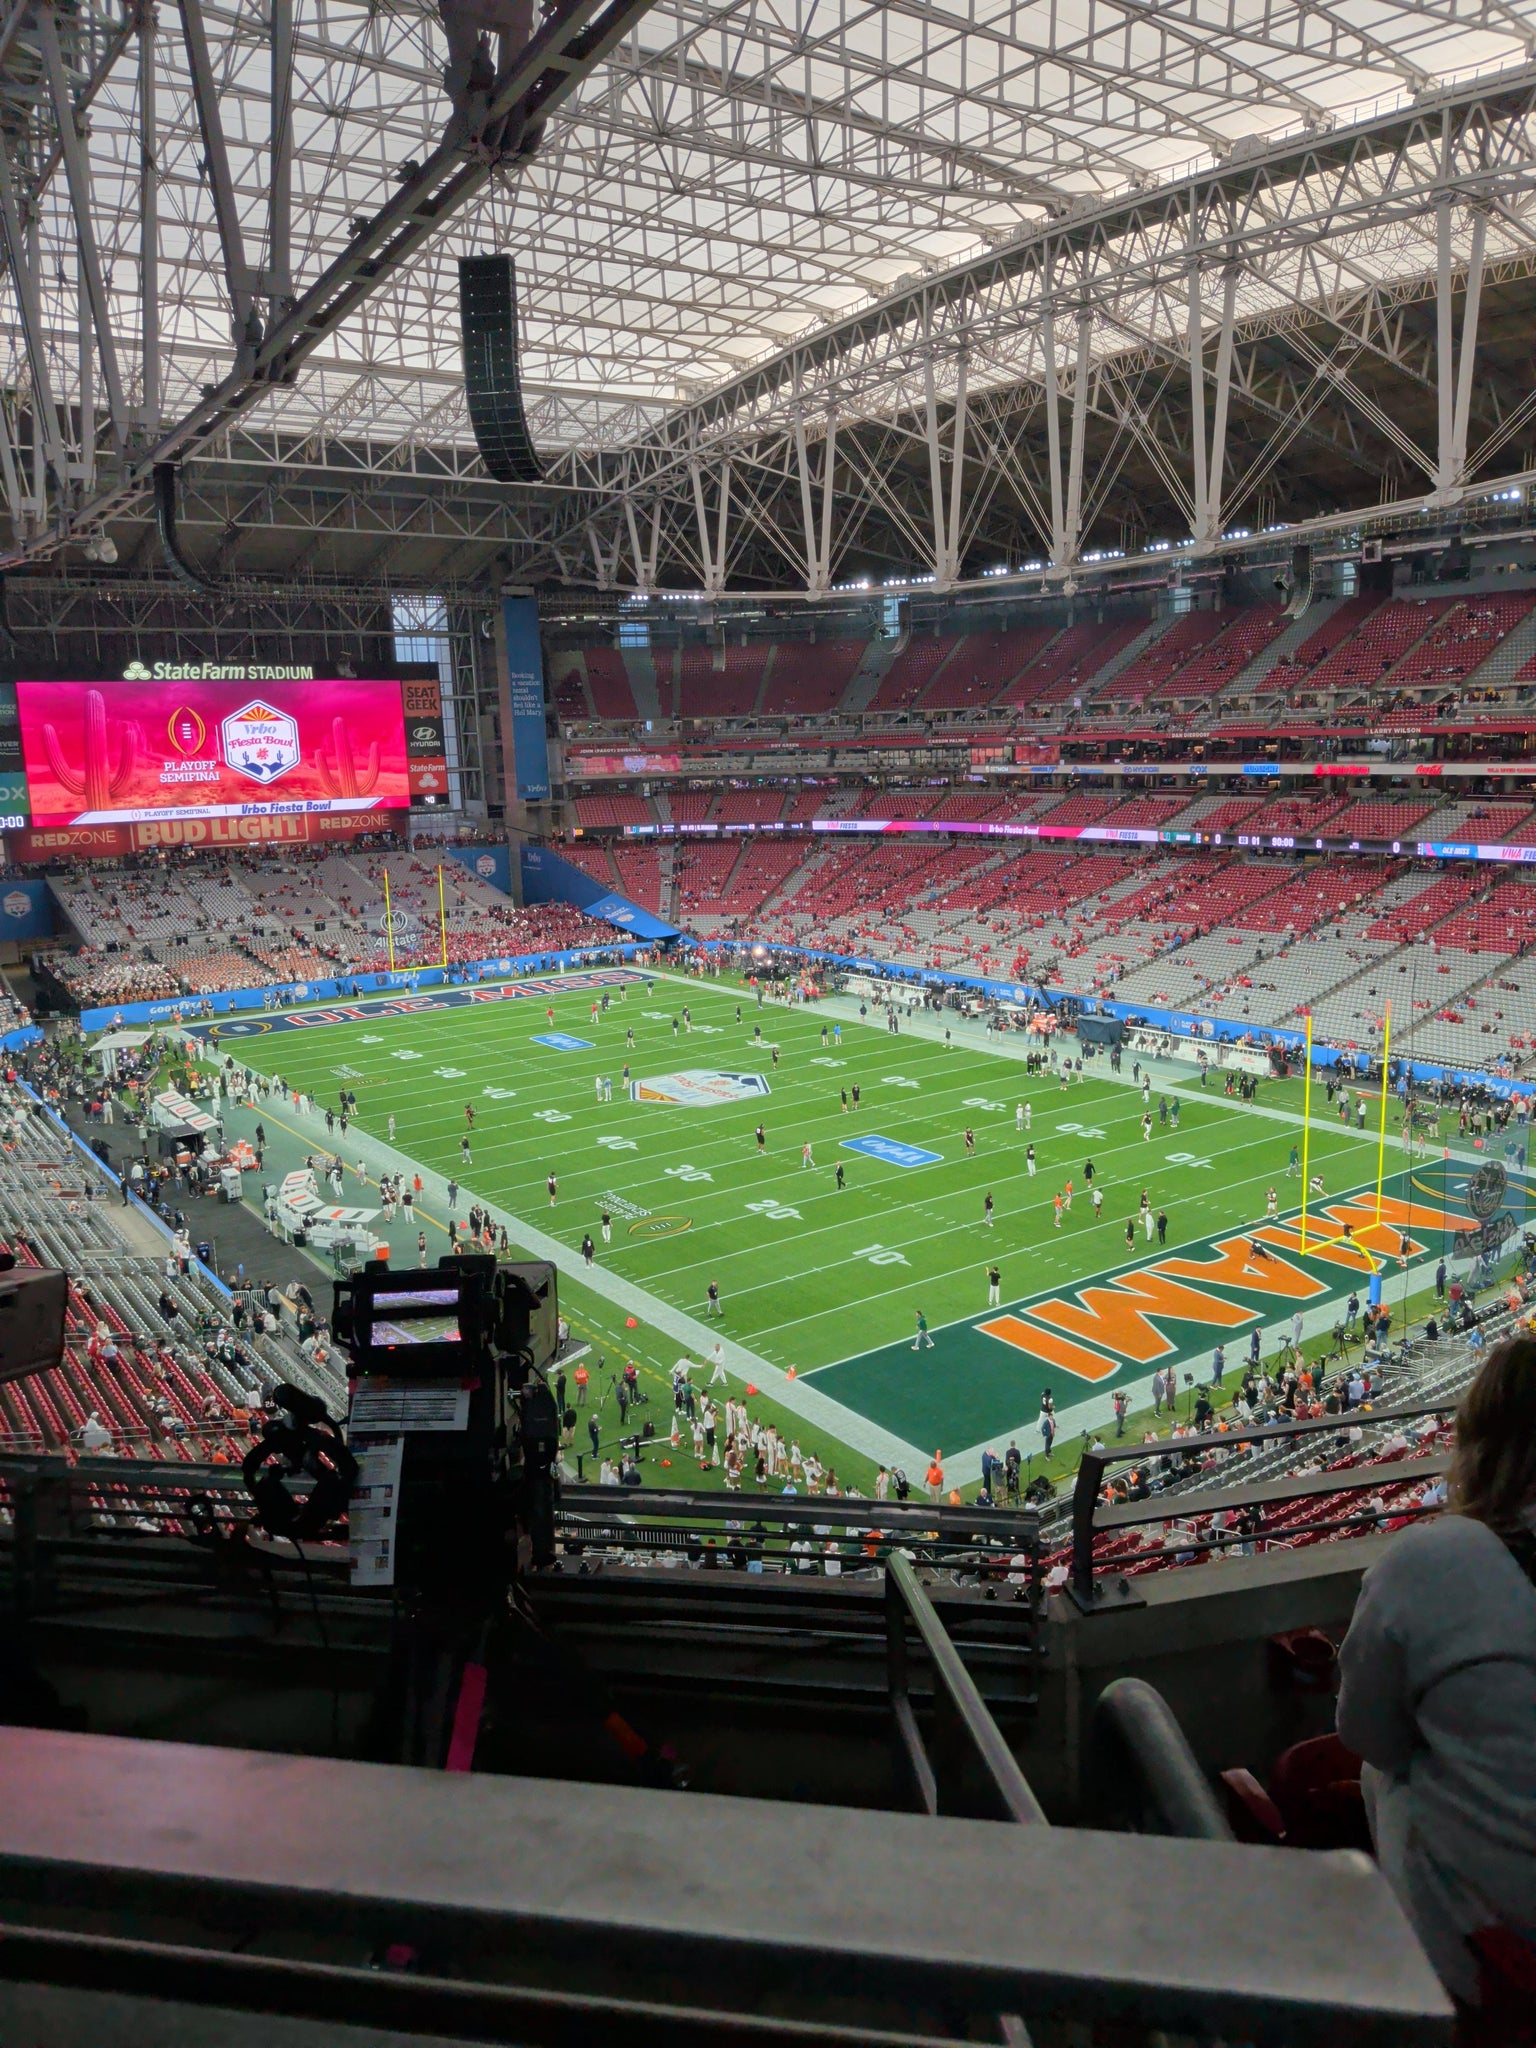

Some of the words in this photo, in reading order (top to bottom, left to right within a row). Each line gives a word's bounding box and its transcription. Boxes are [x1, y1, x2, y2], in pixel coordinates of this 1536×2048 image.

[248, 666, 314, 680] STADIUM
[407, 686, 435, 699] SEAT
[406, 699, 438, 711] GEEK
[244, 723, 277, 735] Vrbo
[228, 736, 263, 749] Fiesta
[263, 735, 294, 748] Bowl
[163, 760, 217, 772] PLAYOFF
[1189, 765, 1208, 774] COX
[527, 784, 548, 793] Vrbo
[175, 808, 211, 816] SEMIFINAL
[241, 803, 267, 815] Vrbo
[269, 802, 303, 813] Fiesta
[305, 800, 332, 812] Bowl
[320, 814, 390, 830] REDZONE
[1004, 824, 1023, 834] Fiesta
[137, 820, 207, 846] BUD
[210, 814, 302, 841] LIGHT
[1119, 831, 1138, 840] FIESTA
[30, 829, 118, 848] REDZONE
[1271, 836, 1294, 848] 90:00
[1501, 848, 1522, 859] VIVA
[374, 933, 417, 948] Allstate
[284, 996, 449, 1027] OLE
[460, 970, 643, 1001] MISS
[532, 1109, 573, 1123] 50
[1055, 1122, 1108, 1140] 20
[596, 1135, 636, 1151] 40
[663, 1164, 712, 1182] 30
[743, 1199, 800, 1220] 20
[851, 1243, 905, 1266] 10
[972, 1191, 1482, 1384] MIAMI
